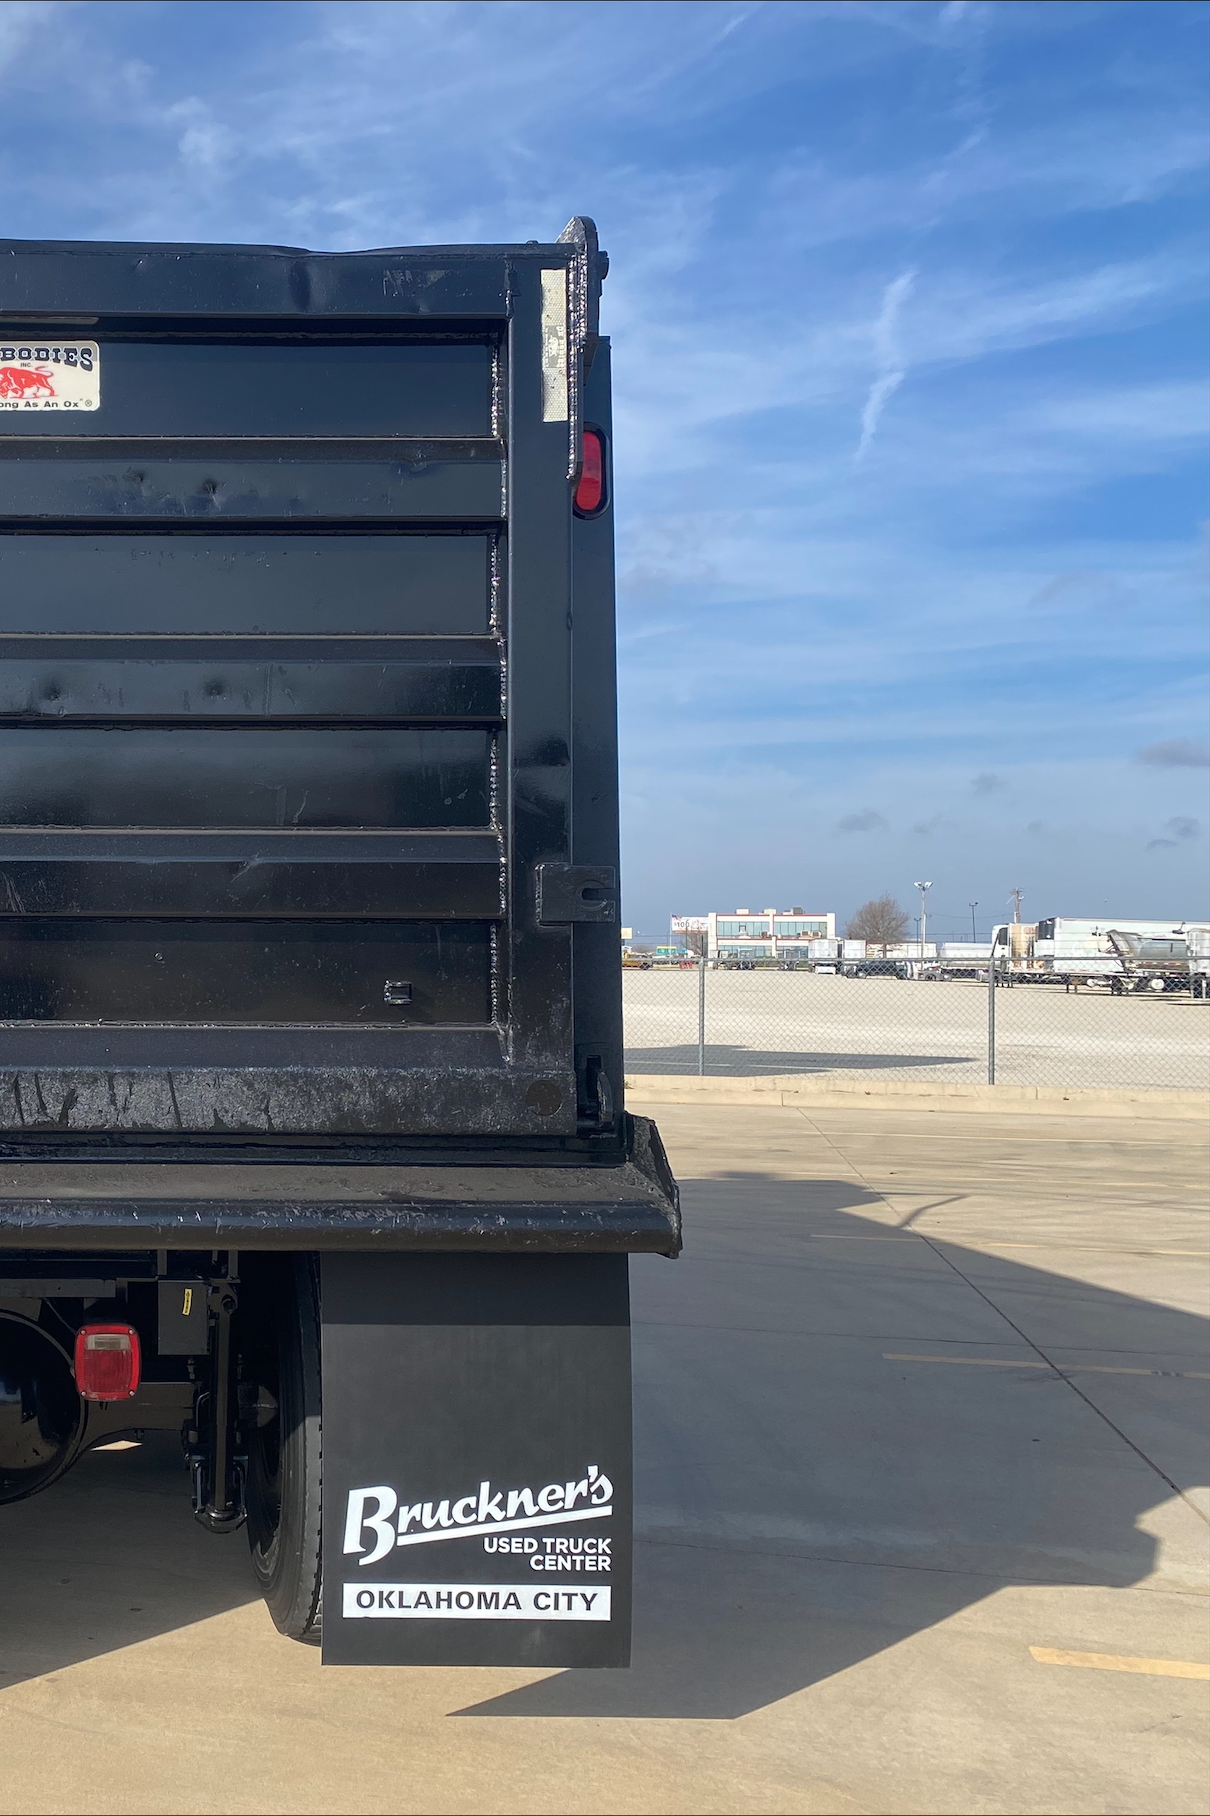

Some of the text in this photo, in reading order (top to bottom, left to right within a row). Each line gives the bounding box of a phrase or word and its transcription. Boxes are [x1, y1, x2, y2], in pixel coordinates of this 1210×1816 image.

[0, 347, 93, 371] BODIES
[343, 1464, 613, 1566] Bruckner's
[484, 1537, 612, 1554] USED TRUCK
[529, 1555, 612, 1571] CENTER
[356, 1590, 598, 1611] OKLAHOMA CITY
